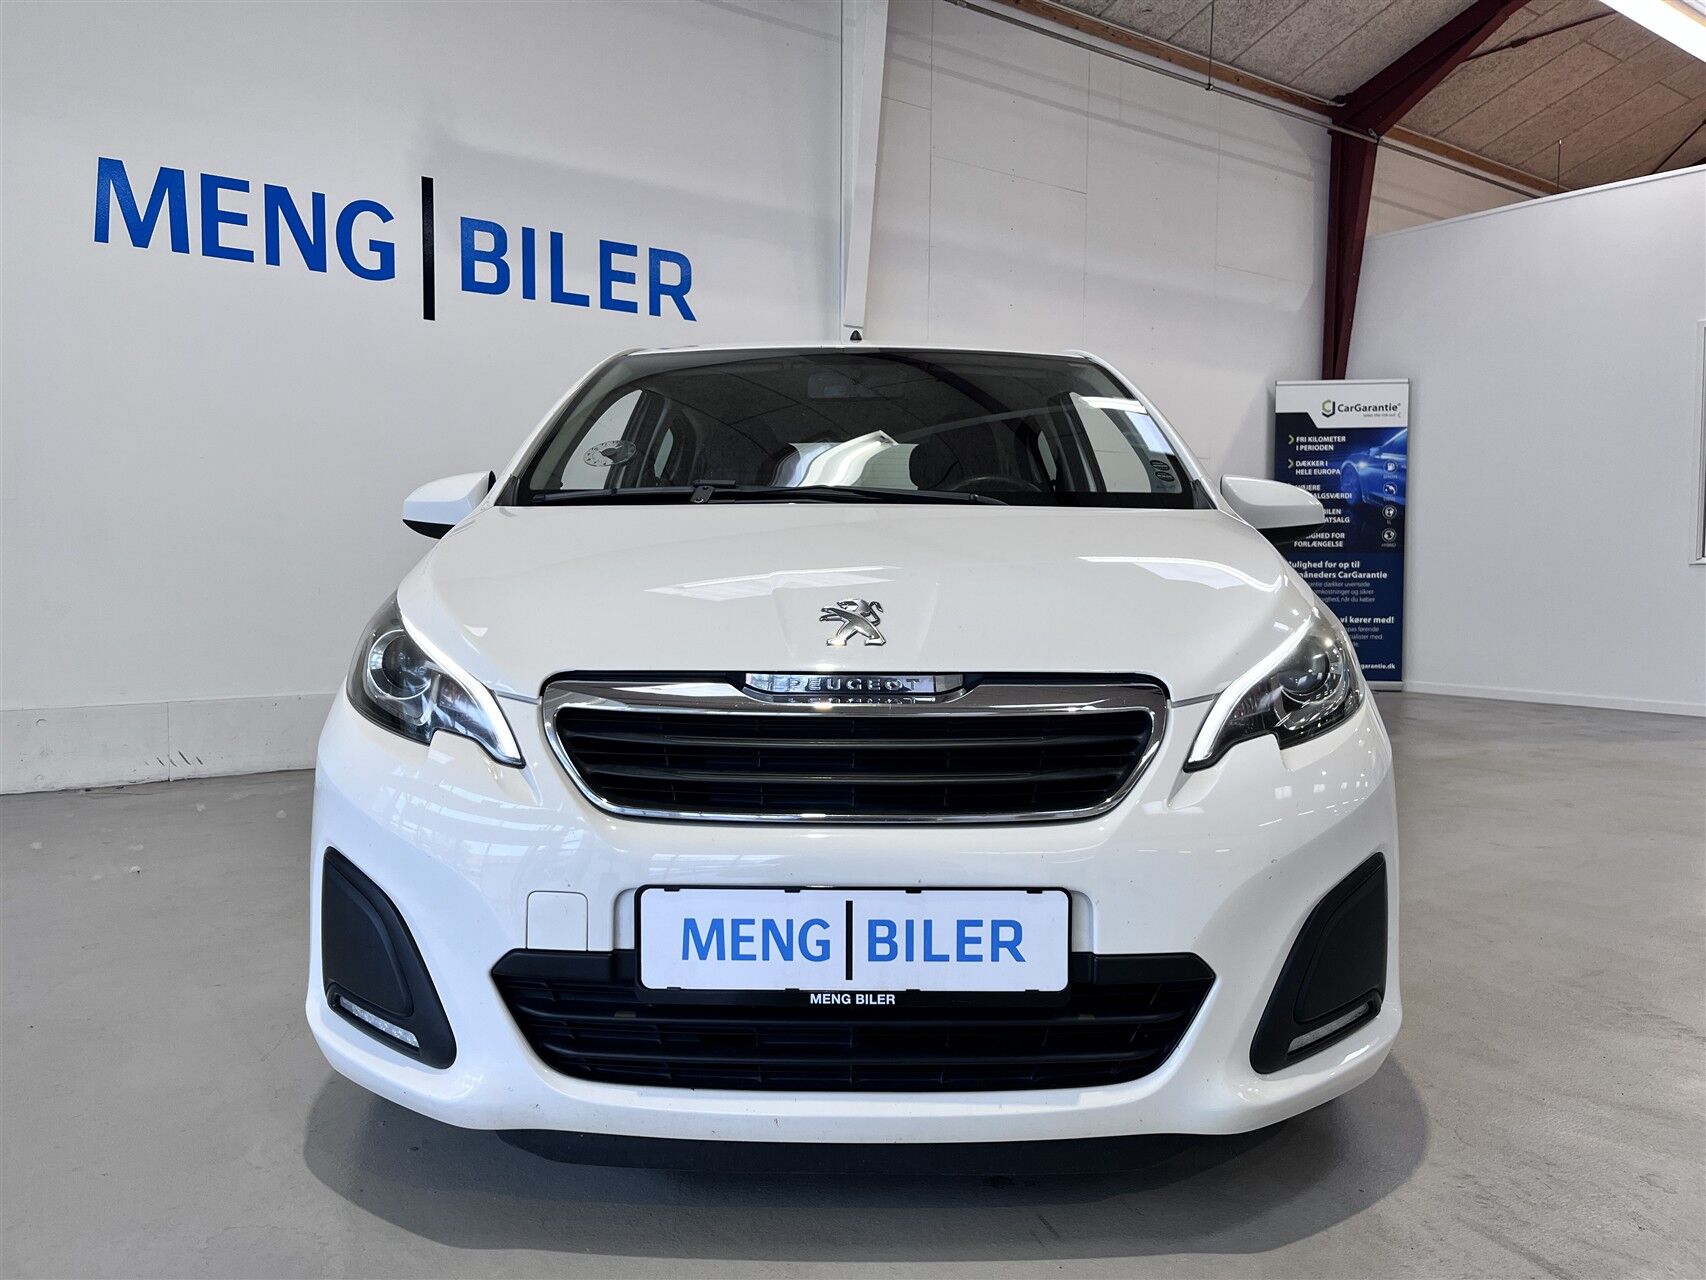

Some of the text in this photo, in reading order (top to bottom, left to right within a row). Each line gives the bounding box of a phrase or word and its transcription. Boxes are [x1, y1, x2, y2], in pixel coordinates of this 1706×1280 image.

[94, 157, 697, 321] MENG BILER
[1289, 561, 1323, 569] ulighed
[1338, 571, 1388, 579] CarGarantie
[789, 678, 920, 691] PEUGEOT
[681, 918, 1027, 962] MENG BILER
[810, 993, 896, 1005] MENG BILER
